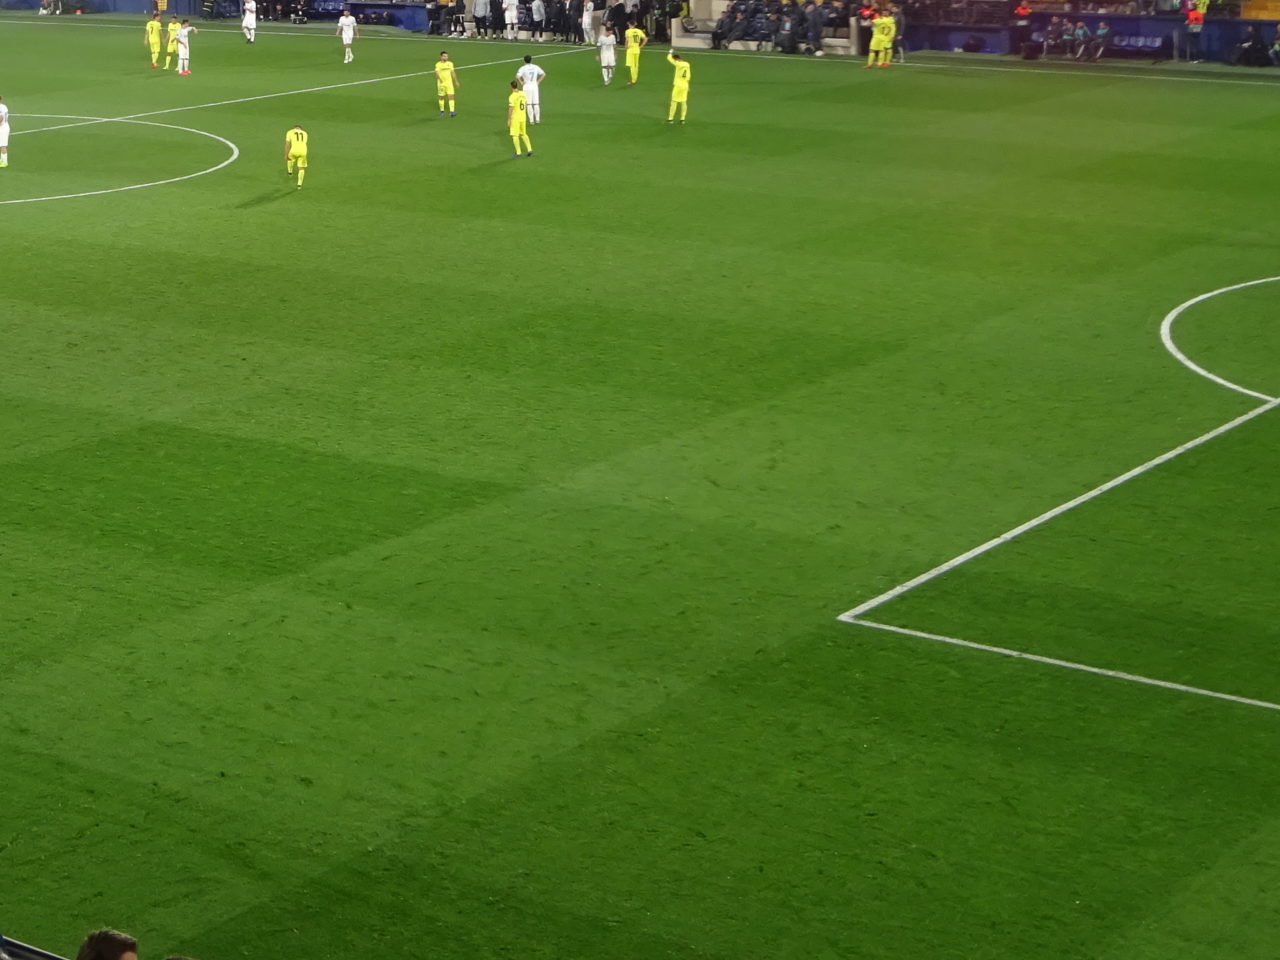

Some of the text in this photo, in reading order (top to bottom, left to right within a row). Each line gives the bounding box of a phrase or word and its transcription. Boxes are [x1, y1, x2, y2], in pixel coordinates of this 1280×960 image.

[632, 34, 641, 44] 10
[529, 71, 535, 81] 7
[520, 100, 525, 111] 6
[294, 131, 304, 142] 11
